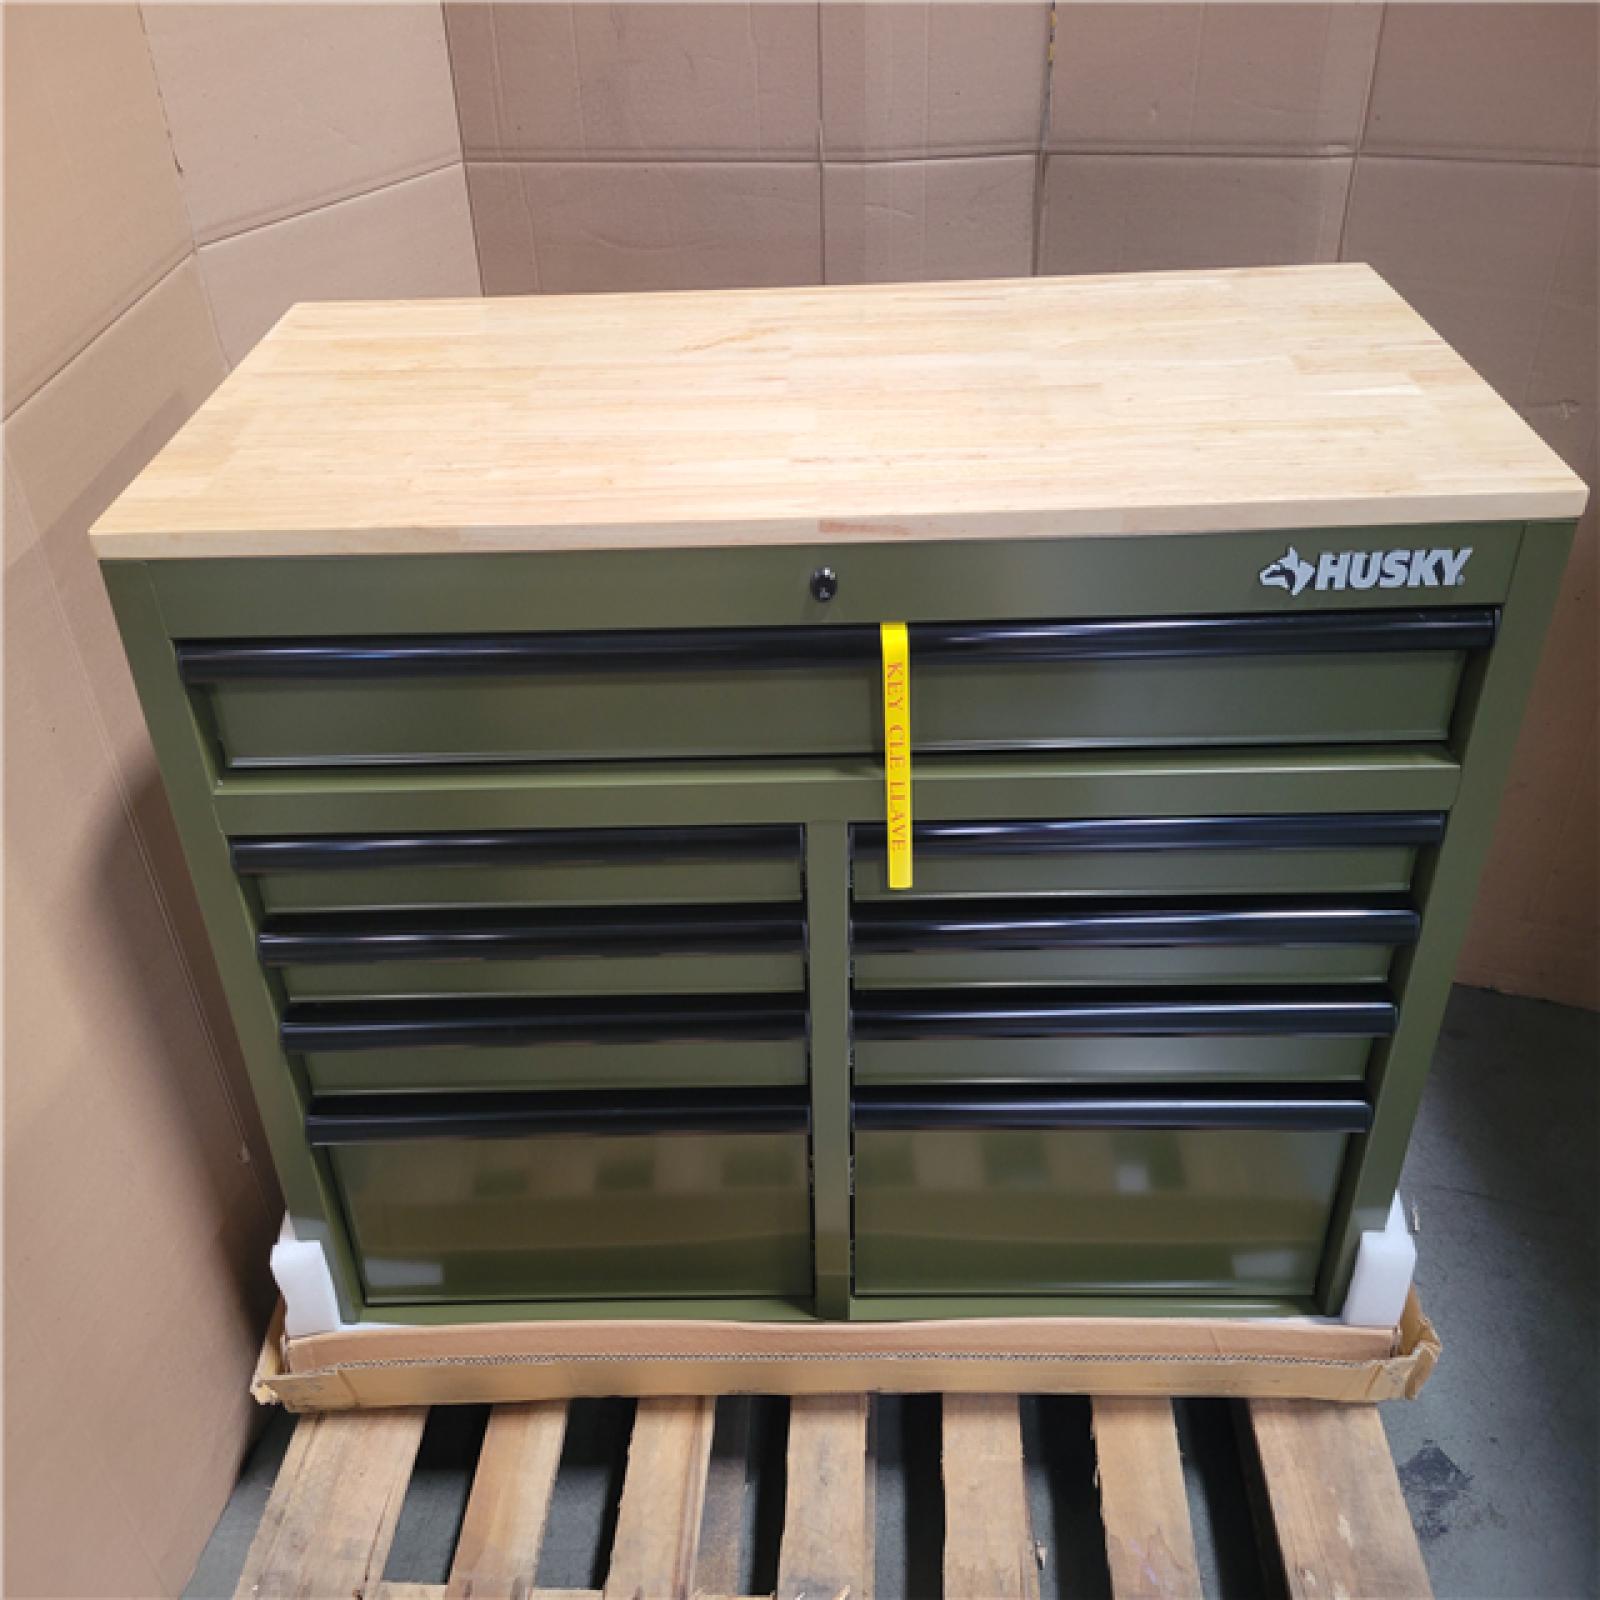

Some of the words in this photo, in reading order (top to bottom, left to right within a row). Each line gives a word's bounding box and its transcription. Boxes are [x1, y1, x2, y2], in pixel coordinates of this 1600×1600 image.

[1314, 547, 1473, 591] HUSKY
[887, 662, 904, 711] KEY
[889, 724, 906, 770] CLE
[889, 781, 907, 851] LLAVE
